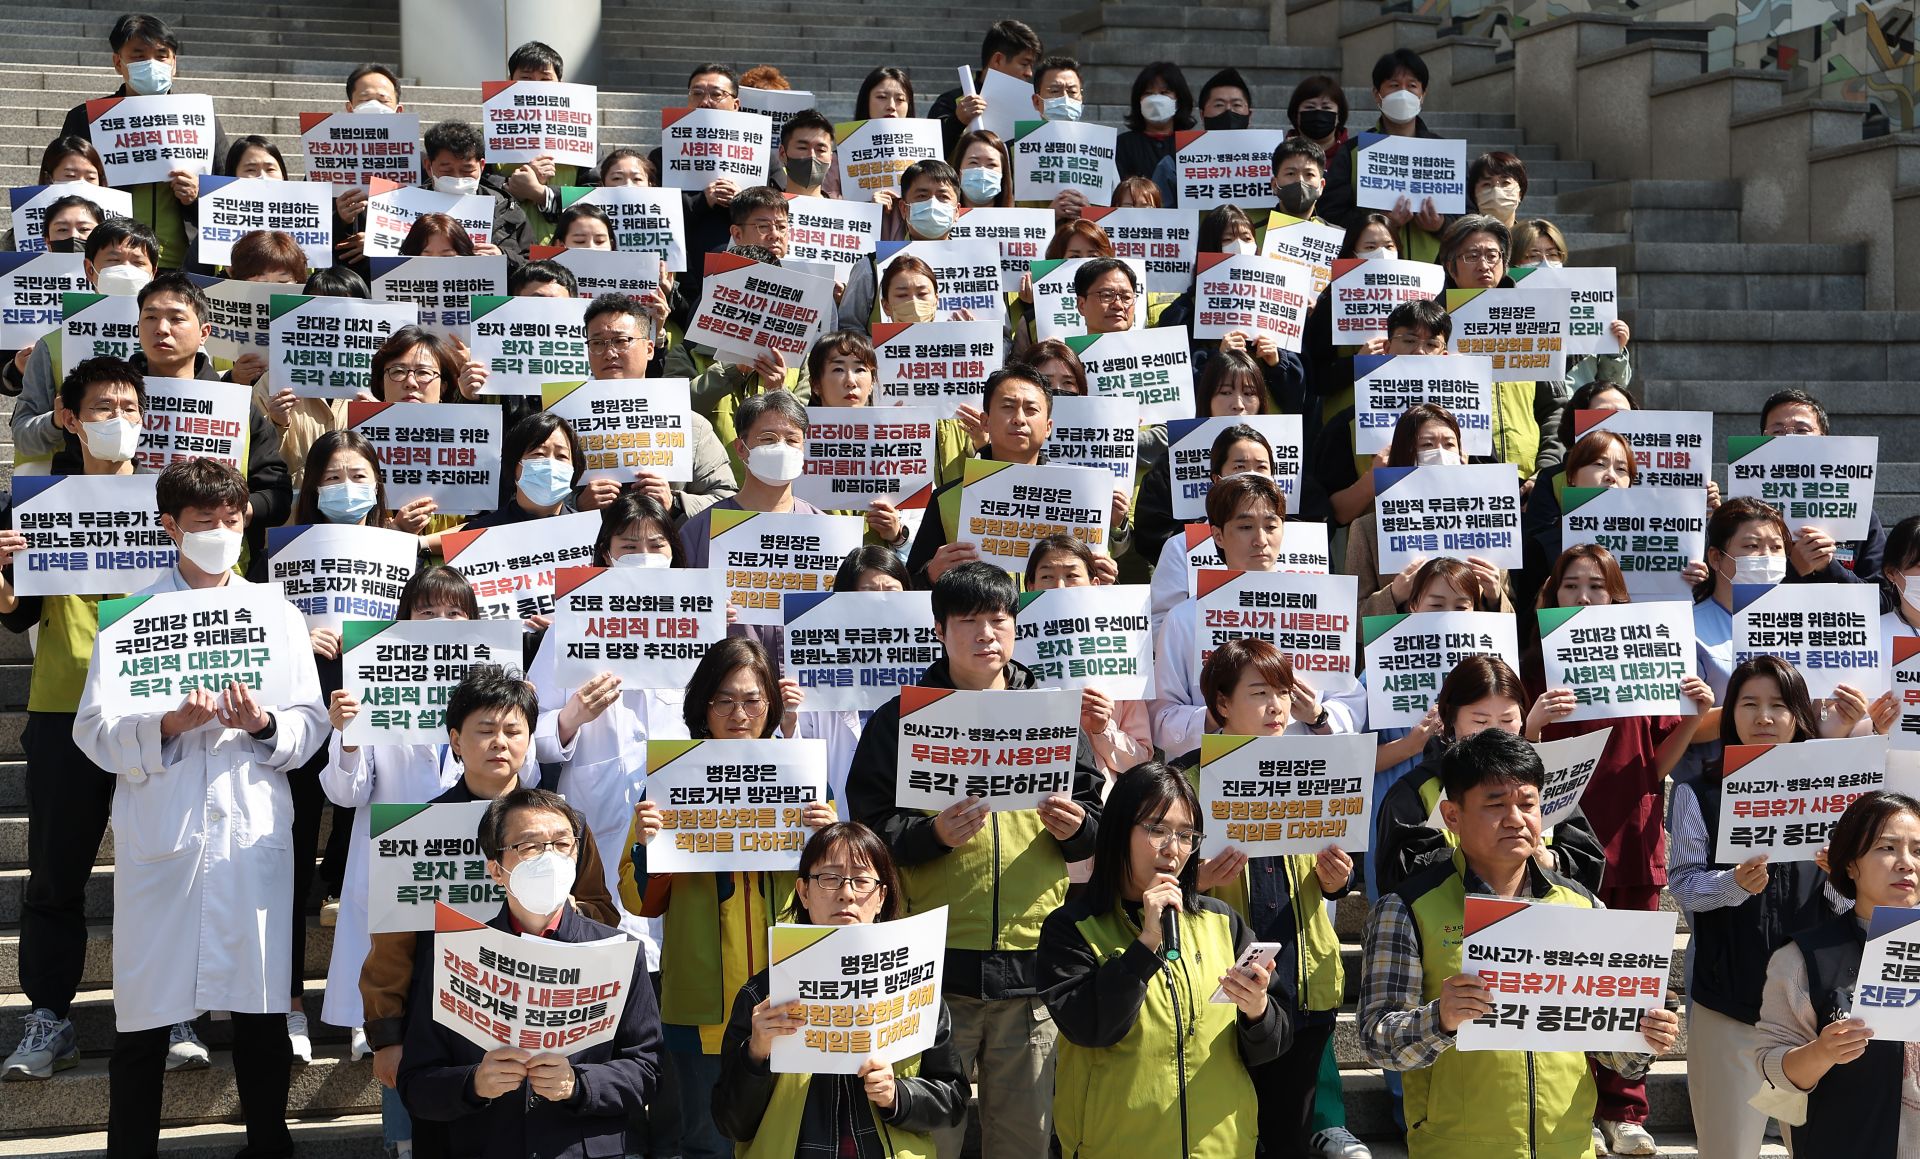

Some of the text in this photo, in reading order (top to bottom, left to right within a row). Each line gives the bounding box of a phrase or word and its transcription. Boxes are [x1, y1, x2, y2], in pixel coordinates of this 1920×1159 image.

[514, 95, 569, 107] 불법의료에
[100, 115, 205, 131] 진료 정상화를 위한
[490, 109, 592, 125] 간호사가 내몰린다
[115, 130, 198, 148] 사회적 대화
[496, 123, 586, 137] 진료거부 전공의들
[672, 127, 762, 144] 진료 정상화를 위한
[489, 137, 593, 154] 병원으로 돌아오라!
[872, 133, 914, 146] 병원장은
[104, 148, 208, 164] 지금 당장 추진하라!
[681, 142, 753, 161] 사회적 대화
[851, 147, 895, 162] 진료거부
[1020, 142, 1113, 159] 환자 생명이 우선이다
[670, 160, 761, 176] 지금 당장 추진하라!
[1039, 156, 1098, 172] 환자 곁으로
[1369, 152, 1455, 168] 국민생명 위협하는
[1030, 171, 1102, 188] 즉각 돌아오라!
[1368, 164, 1455, 180] 진료거부 명분없다
[1360, 176, 1463, 194] 진료거부 중단하라!
[1230, 268, 1285, 286] 불법의료에
[745, 277, 803, 303] 불법의료에
[1203, 282, 1303, 308] 간호사가 내몰린다
[713, 285, 818, 324] 간호사가 내몰린다
[1208, 297, 1298, 320] 진료거부 전공의들
[712, 302, 808, 337] 진료거부 전공의들
[1200, 312, 1300, 338] 병원으로 돌아오라!
[697, 314, 807, 355] 병원으로 돌아오라!
[885, 343, 994, 358] 진료 정상화를 위한
[897, 361, 984, 379] 사회적 대화
[883, 383, 940, 396] 지금 당장
[361, 427, 489, 443] 진료 정상화를 위한
[377, 446, 476, 466] 사회적 대화
[393, 470, 489, 485] 당장 추진하라!
[1735, 464, 1873, 479] 환자 생명이 우선이다
[1762, 482, 1849, 498] 환자 곁으로
[1382, 496, 1515, 515] 일방적 무급휴가 강요
[1790, 502, 1857, 518] 돌아오라!
[20, 511, 148, 529] 일방적 무급휴가
[1382, 513, 1517, 532] 병원노동자가 위태롭다
[1390, 532, 1511, 552] 대책을 마련하라!
[29, 552, 88, 571] 대책을
[570, 596, 713, 612] 진료 정상화를 위한
[134, 608, 251, 634] 강대강 대치 속
[585, 617, 699, 638] 사회적 대화
[1748, 612, 1865, 628] 국민생명 위협하는
[116, 627, 266, 654] 국민건강 위태롭다
[1570, 624, 1669, 644] 강대강 대치 속
[1748, 631, 1867, 647] 진료거부 명분없다
[567, 643, 639, 659] 지금 당장
[1557, 642, 1681, 663] 국민건강 위태롭다
[1806, 651, 1878, 669] 중단하라!
[119, 648, 270, 677] 사회적 대화기구
[1563, 662, 1685, 684] 사회적 대화기구
[130, 677, 172, 697] 즉각
[1573, 687, 1609, 705] 즉각
[1025, 726, 1077, 740] 운운하는
[911, 744, 1071, 766] 무급휴가 사용압력
[1259, 760, 1326, 777] 병원장은
[909, 770, 1069, 798] 즉각 중단하라!
[1223, 777, 1361, 797] 진료거부 방관말고
[1212, 797, 1363, 820] 병원정상화를 위해
[1227, 820, 1347, 842] 책임을 다하라!
[479, 946, 580, 985] 불법의료에
[841, 947, 908, 978] 병원장은
[1608, 953, 1668, 968] 운운하는
[442, 946, 621, 1008] 간호사가 내몰린다
[799, 961, 934, 999] 진료거부 방관말고
[1478, 970, 1660, 997] 무급휴가 사용압력
[449, 976, 607, 1027] 진료거부 전공의들
[908, 984, 935, 1012] 위해
[439, 989, 615, 1050] 병원으로 돌아오라!
[805, 1013, 920, 1053] 책임을 다하라!
